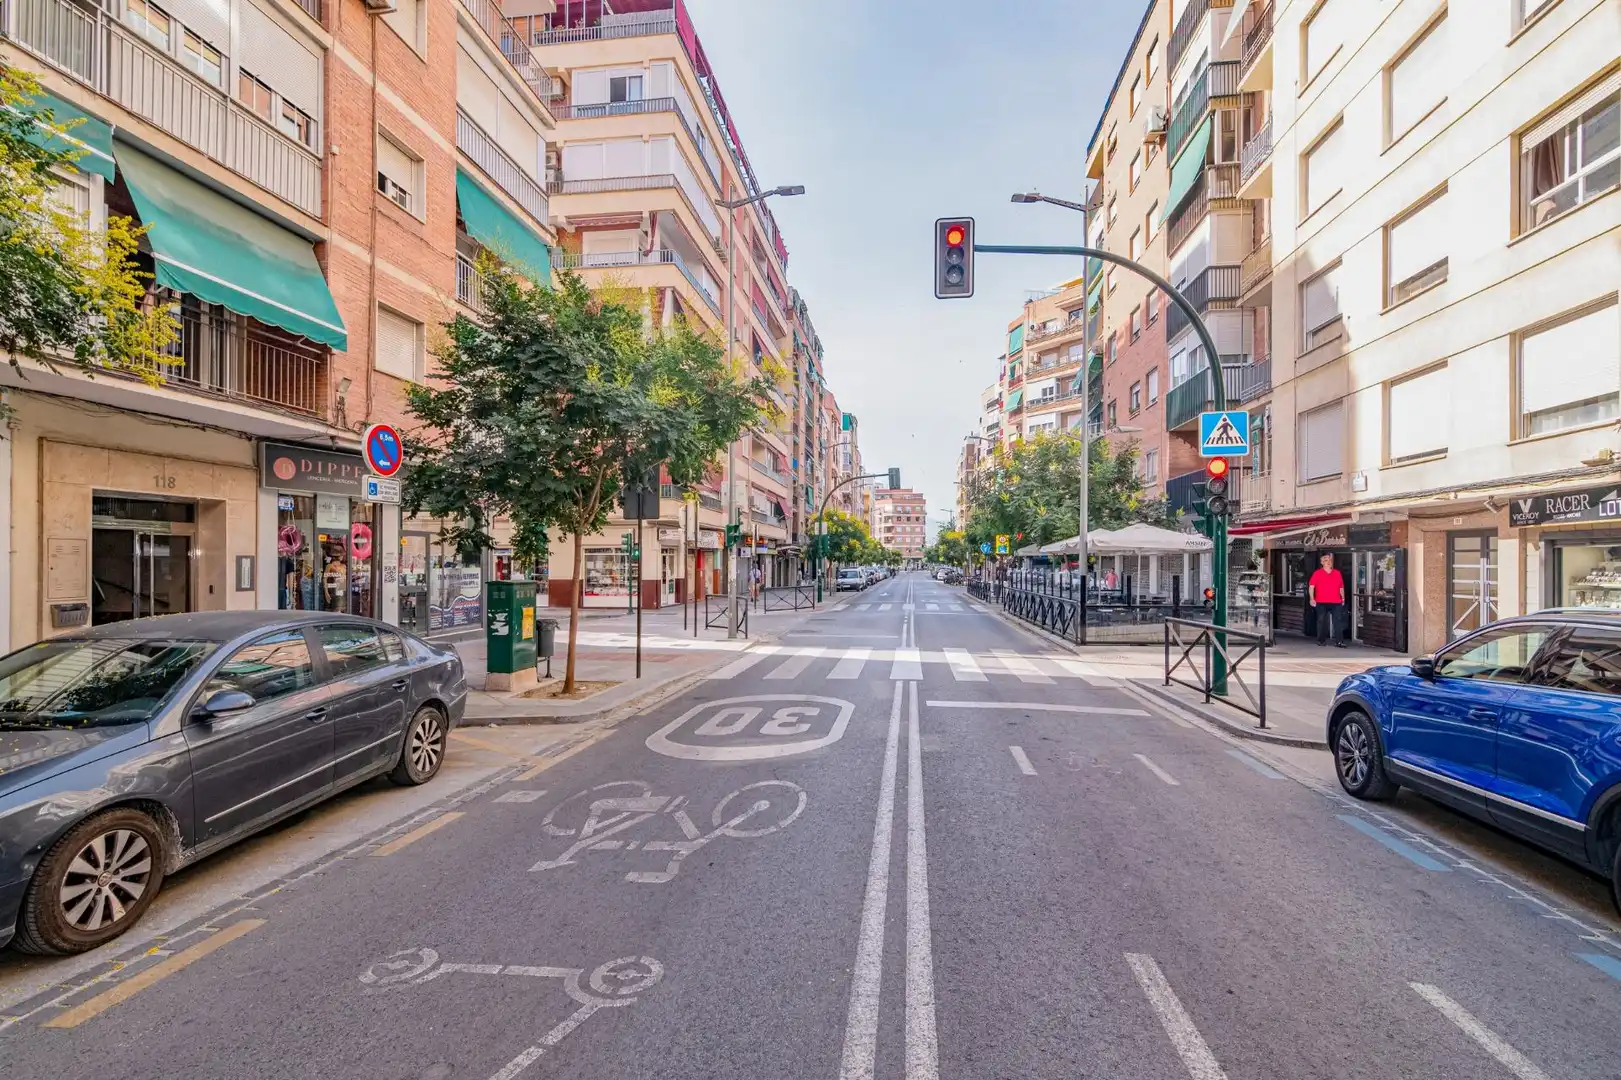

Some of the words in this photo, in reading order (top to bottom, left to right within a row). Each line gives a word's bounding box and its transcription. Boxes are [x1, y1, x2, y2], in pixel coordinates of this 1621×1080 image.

[153, 475, 176, 489] 118
[1546, 494, 1591, 514] RACER
[1513, 512, 1539, 520] VICEROY
[695, 707, 820, 736] 30
